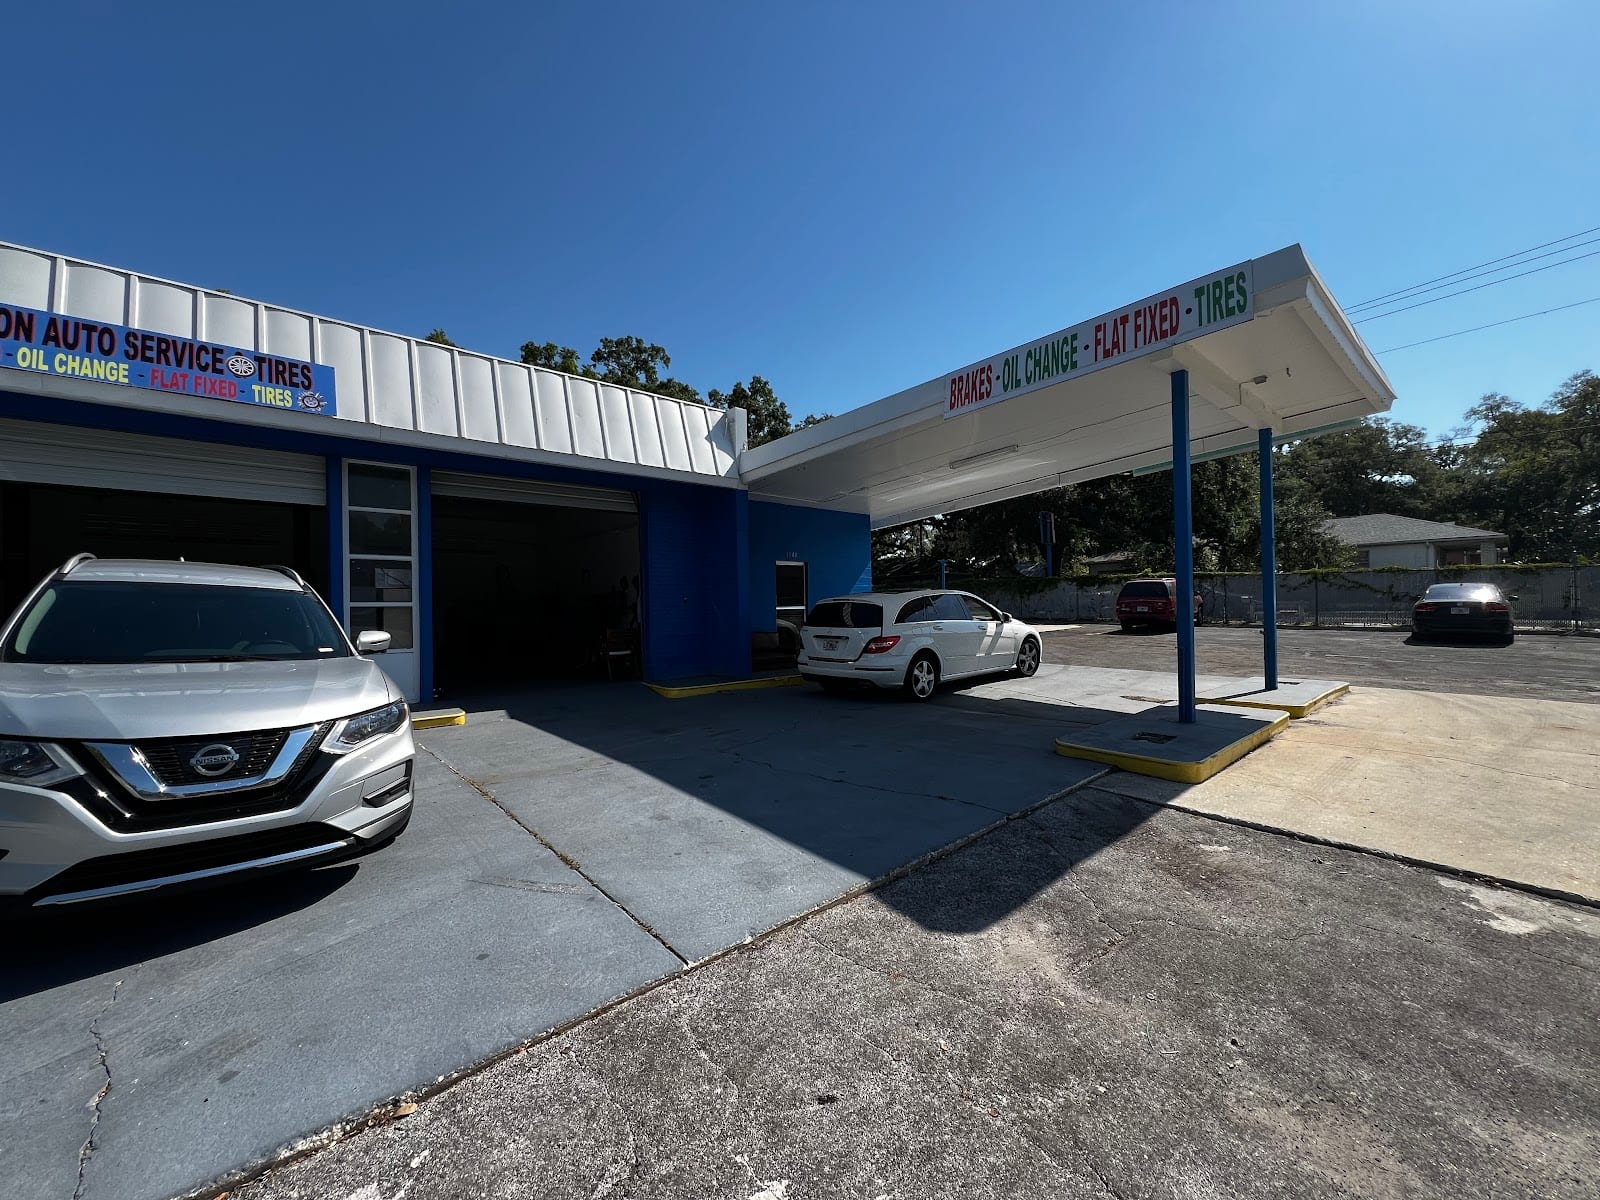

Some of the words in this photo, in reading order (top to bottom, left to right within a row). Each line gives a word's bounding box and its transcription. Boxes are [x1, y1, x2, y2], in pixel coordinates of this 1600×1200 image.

[42, 317, 116, 357] AUTO
[124, 331, 225, 376] SERVICE
[254, 355, 312, 390] TIRES
[950, 364, 992, 410] BRAKES
[1002, 357, 1021, 392] OIL
[1025, 333, 1078, 384] CHANGE
[1094, 314, 1129, 362] FLAT
[1134, 296, 1180, 348] FIXED
[1194, 271, 1248, 327] TIRES
[17, 347, 48, 371] OIL
[54, 353, 128, 383] CHANGE
[151, 369, 188, 391] FLAT
[194, 375, 237, 399] FIXED
[252, 384, 293, 408] TIRES
[196, 755, 234, 765] NISSAN
